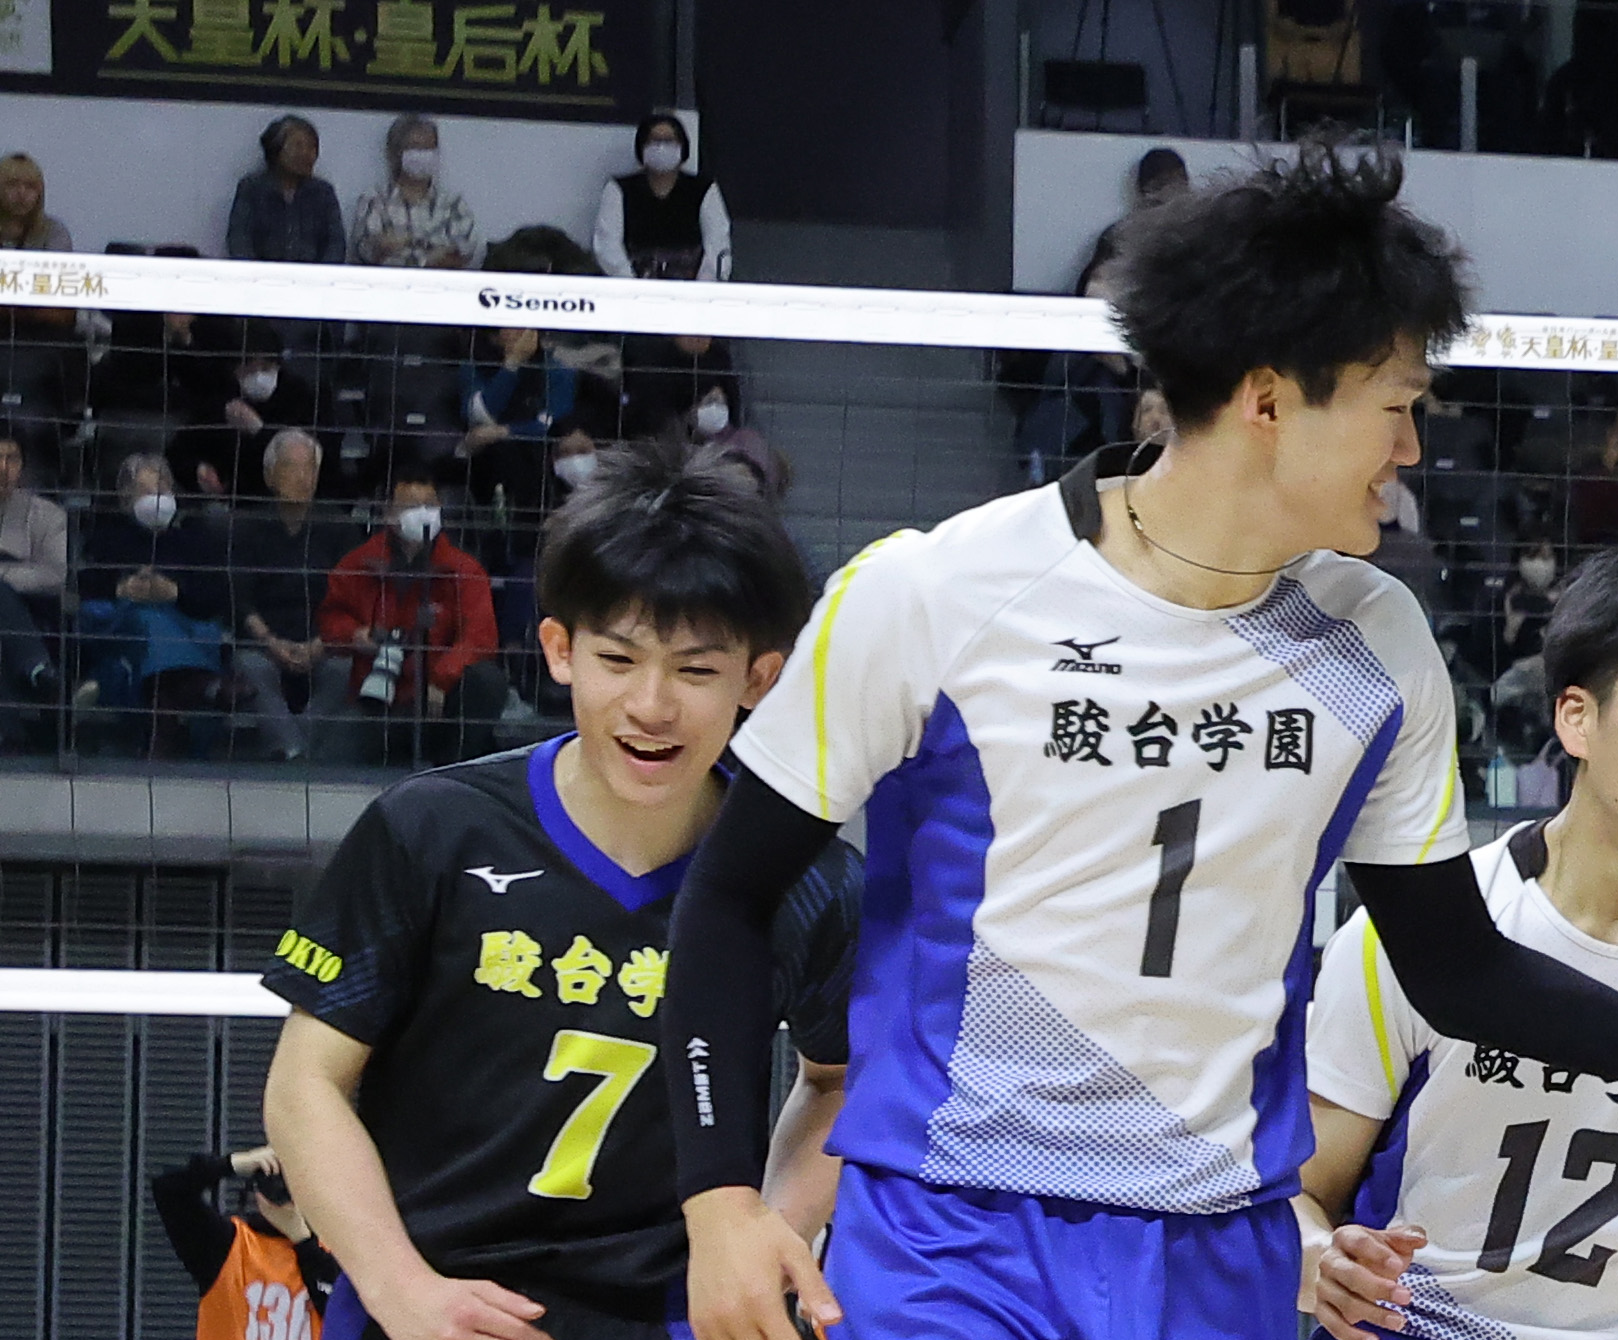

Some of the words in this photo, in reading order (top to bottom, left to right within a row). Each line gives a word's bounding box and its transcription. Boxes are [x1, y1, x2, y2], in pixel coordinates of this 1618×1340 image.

[505, 294, 596, 313] Senoh
[1044, 698, 1315, 775] 駿台学園
[1140, 798, 1203, 979] 1
[527, 1029, 658, 1200] 7
